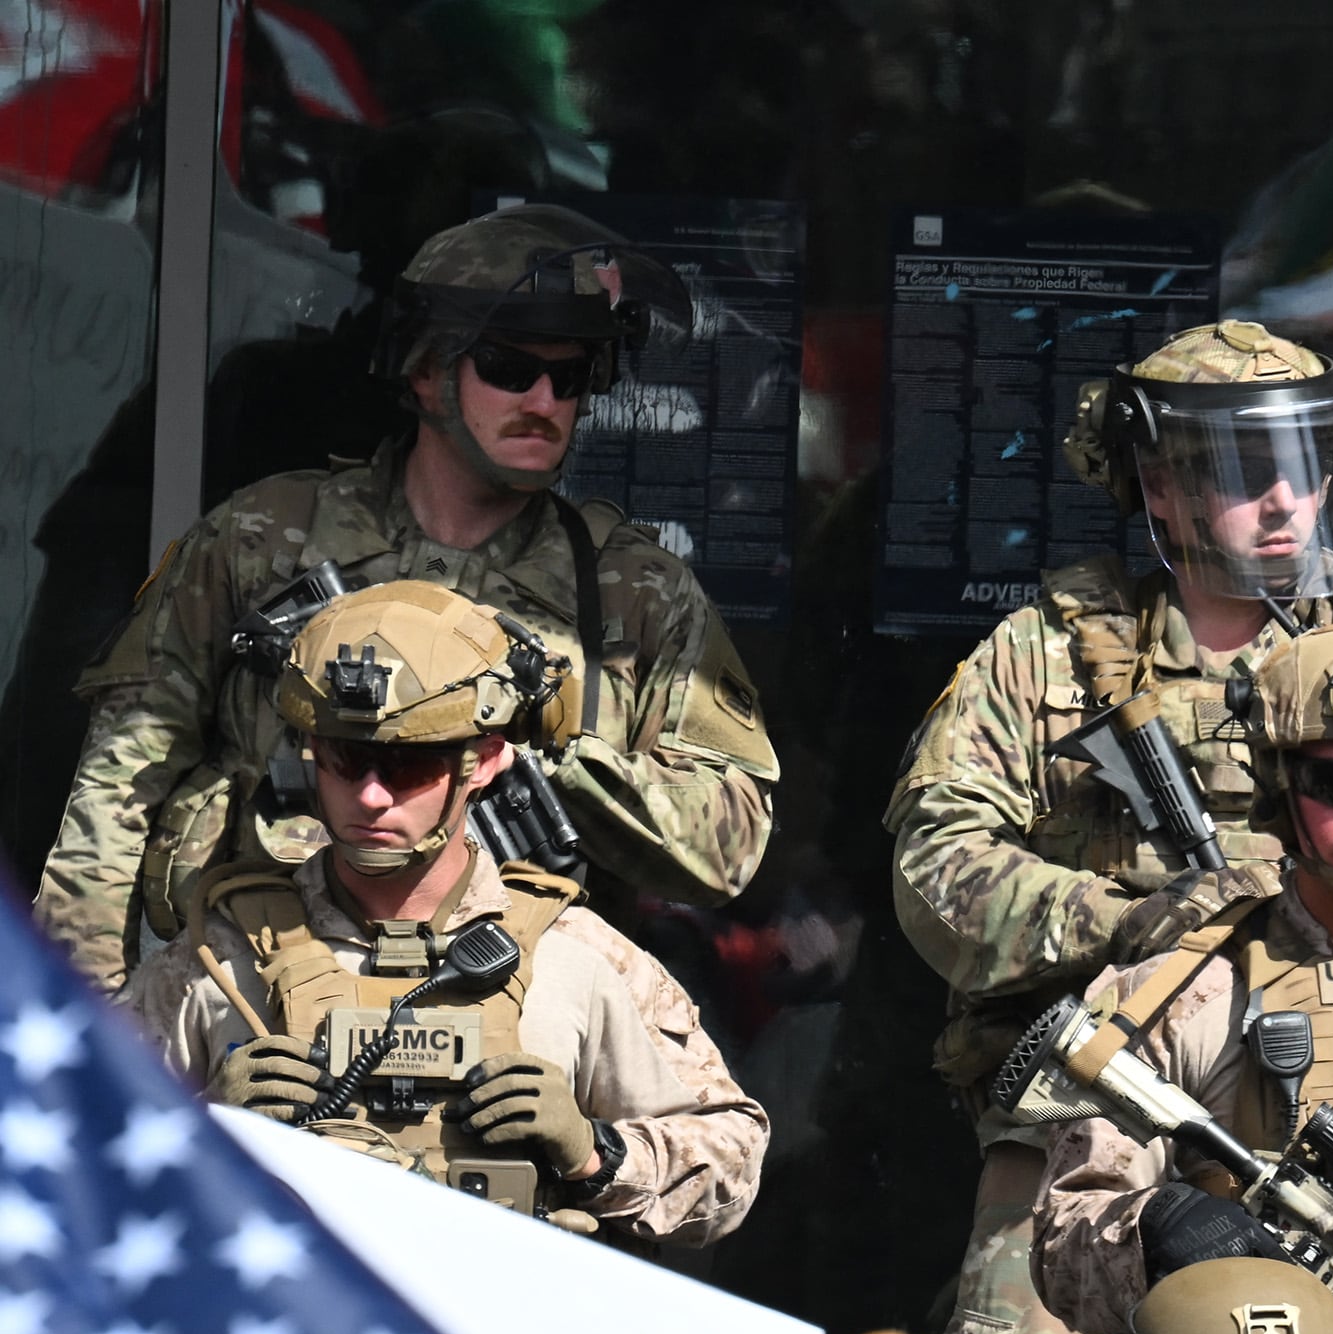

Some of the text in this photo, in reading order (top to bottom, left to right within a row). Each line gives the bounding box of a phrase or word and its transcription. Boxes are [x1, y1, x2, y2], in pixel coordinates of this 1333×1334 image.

[1042, 267, 1065, 280] que
[1068, 266, 1104, 280] Rigen
[1014, 277, 1077, 291] Propiedad
[1080, 278, 1127, 292] Federal
